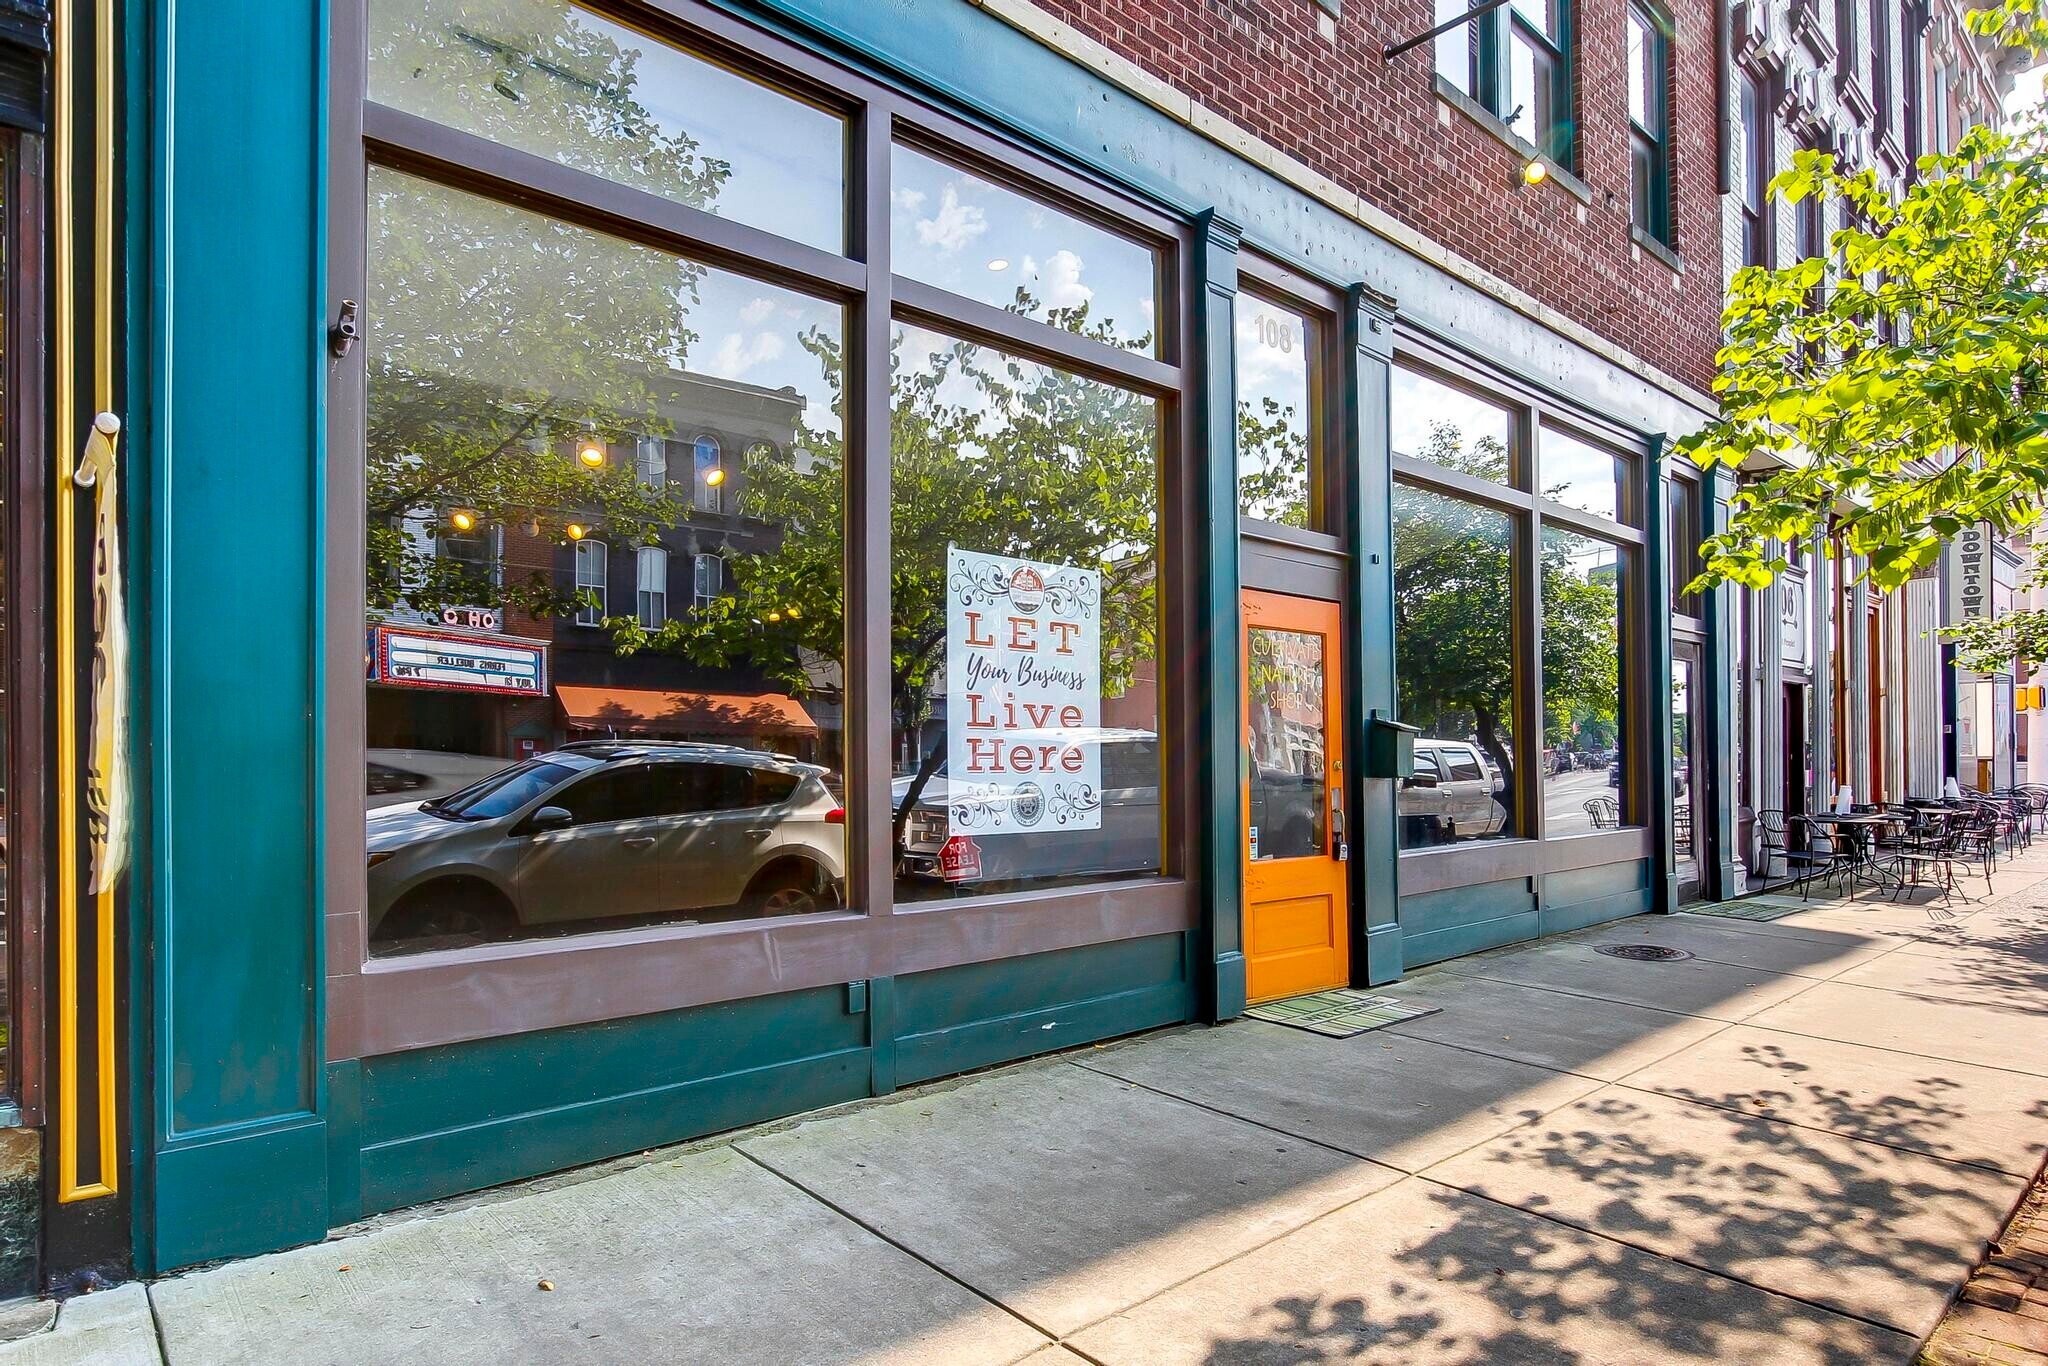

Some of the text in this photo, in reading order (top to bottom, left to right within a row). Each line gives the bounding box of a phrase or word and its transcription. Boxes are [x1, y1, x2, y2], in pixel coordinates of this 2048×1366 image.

[1255, 314, 1291, 353] 108
[1960, 531, 1984, 617] DOWNTOWN
[964, 611, 1081, 656] LET
[1252, 637, 1321, 661] CULTIVATE
[966, 652, 1087, 690] Your Business
[1261, 664, 1314, 691] NATURE
[966, 692, 1083, 730] Live
[1270, 690, 1302, 709] SHOP
[966, 738, 1084, 773] Here
